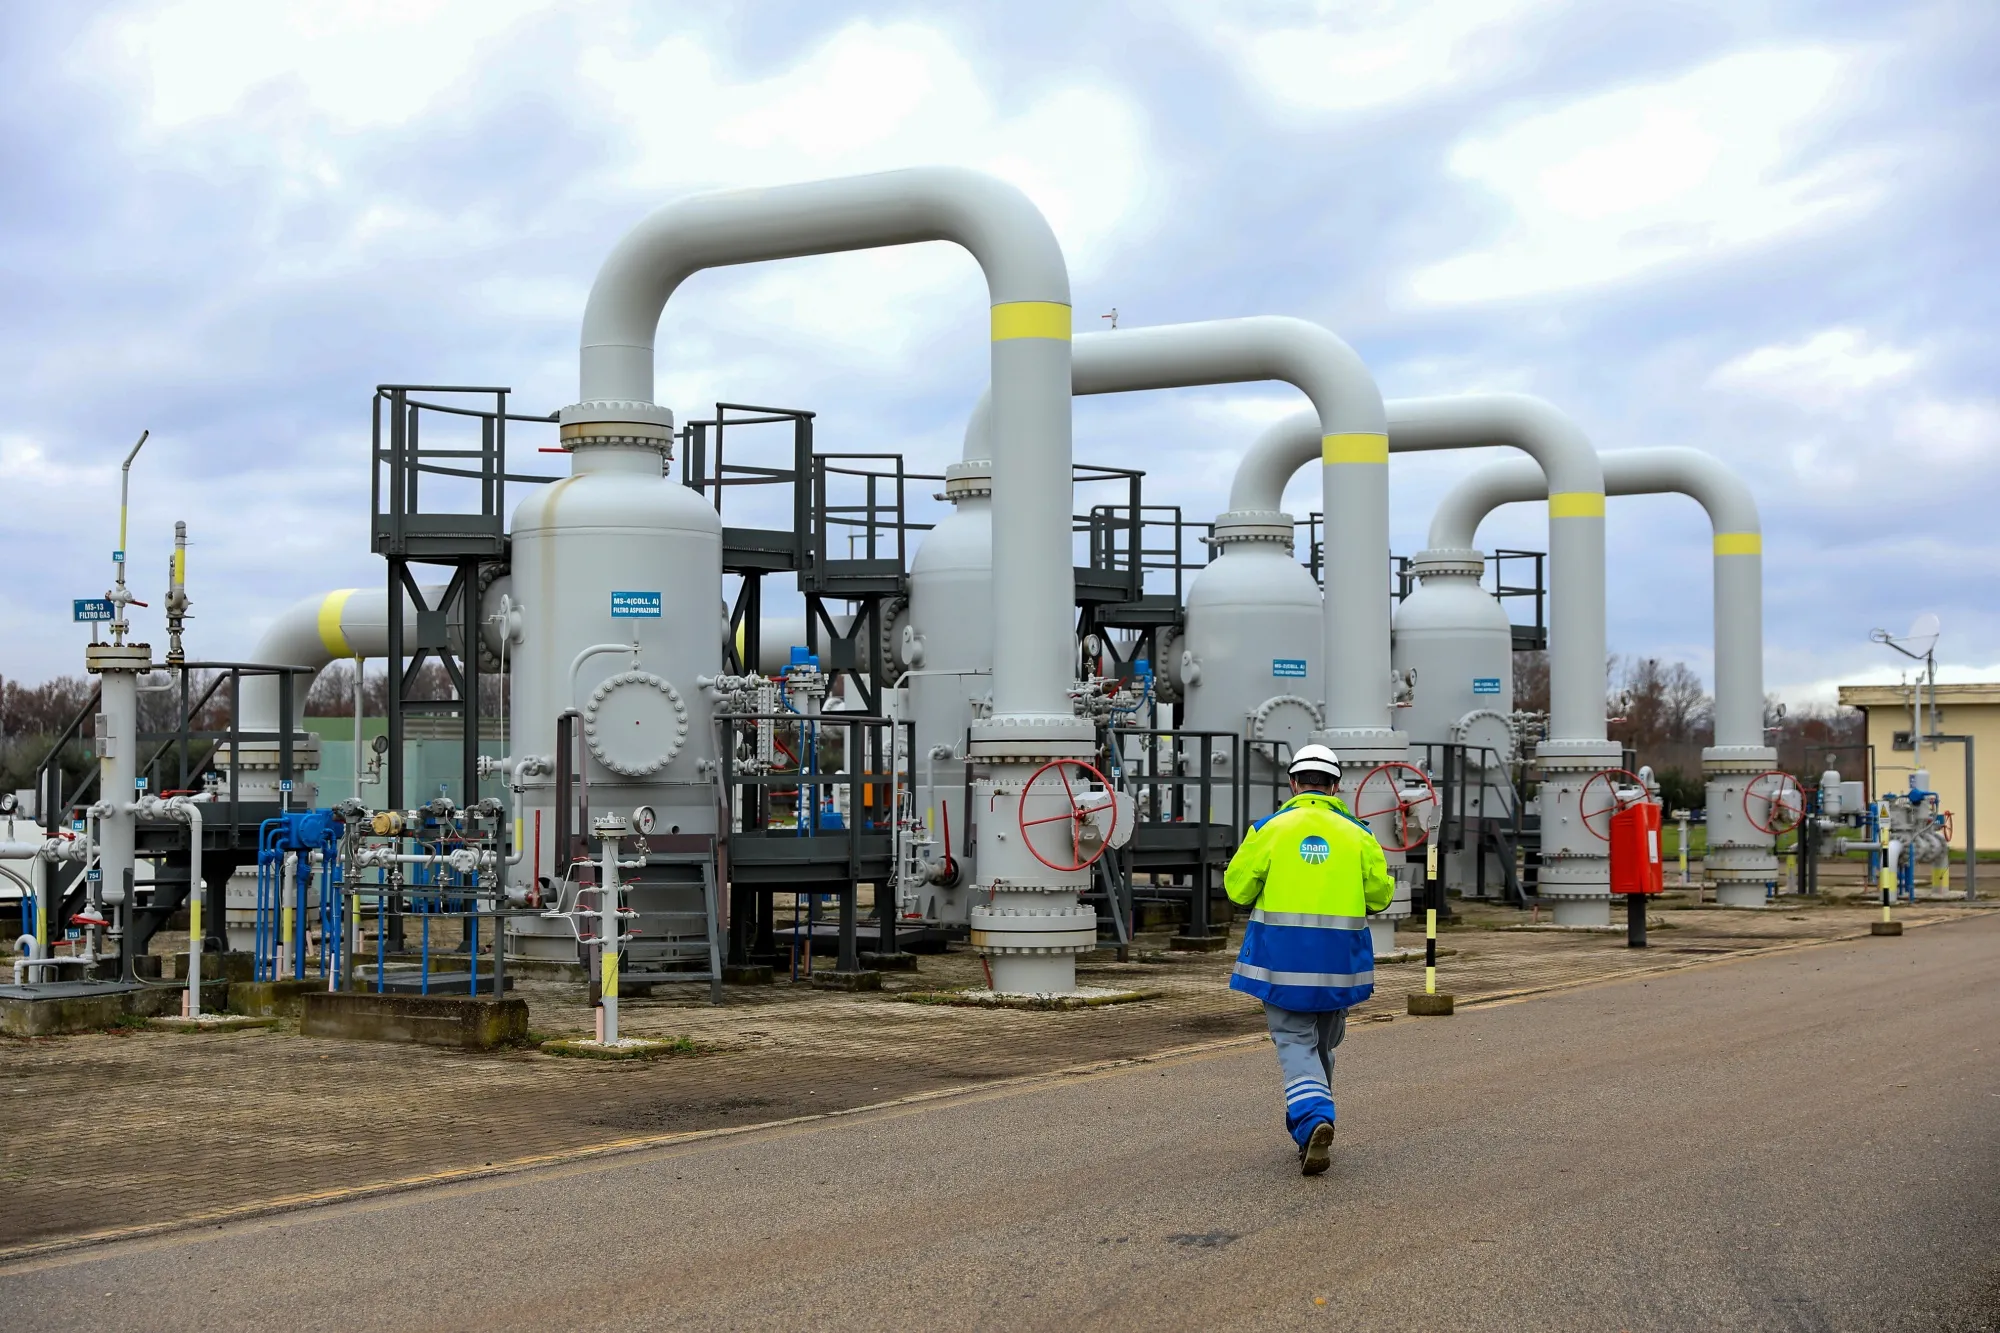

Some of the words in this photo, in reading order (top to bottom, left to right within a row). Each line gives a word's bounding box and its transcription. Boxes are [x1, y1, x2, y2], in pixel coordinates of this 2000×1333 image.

[613, 597, 650, 605] MS-4(COLL.
[652, 598, 659, 606] A)
[84, 603, 104, 611] MS-13
[79, 611, 98, 619] FILTRO
[99, 611, 111, 619] GAS
[1301, 843, 1328, 852] snam
